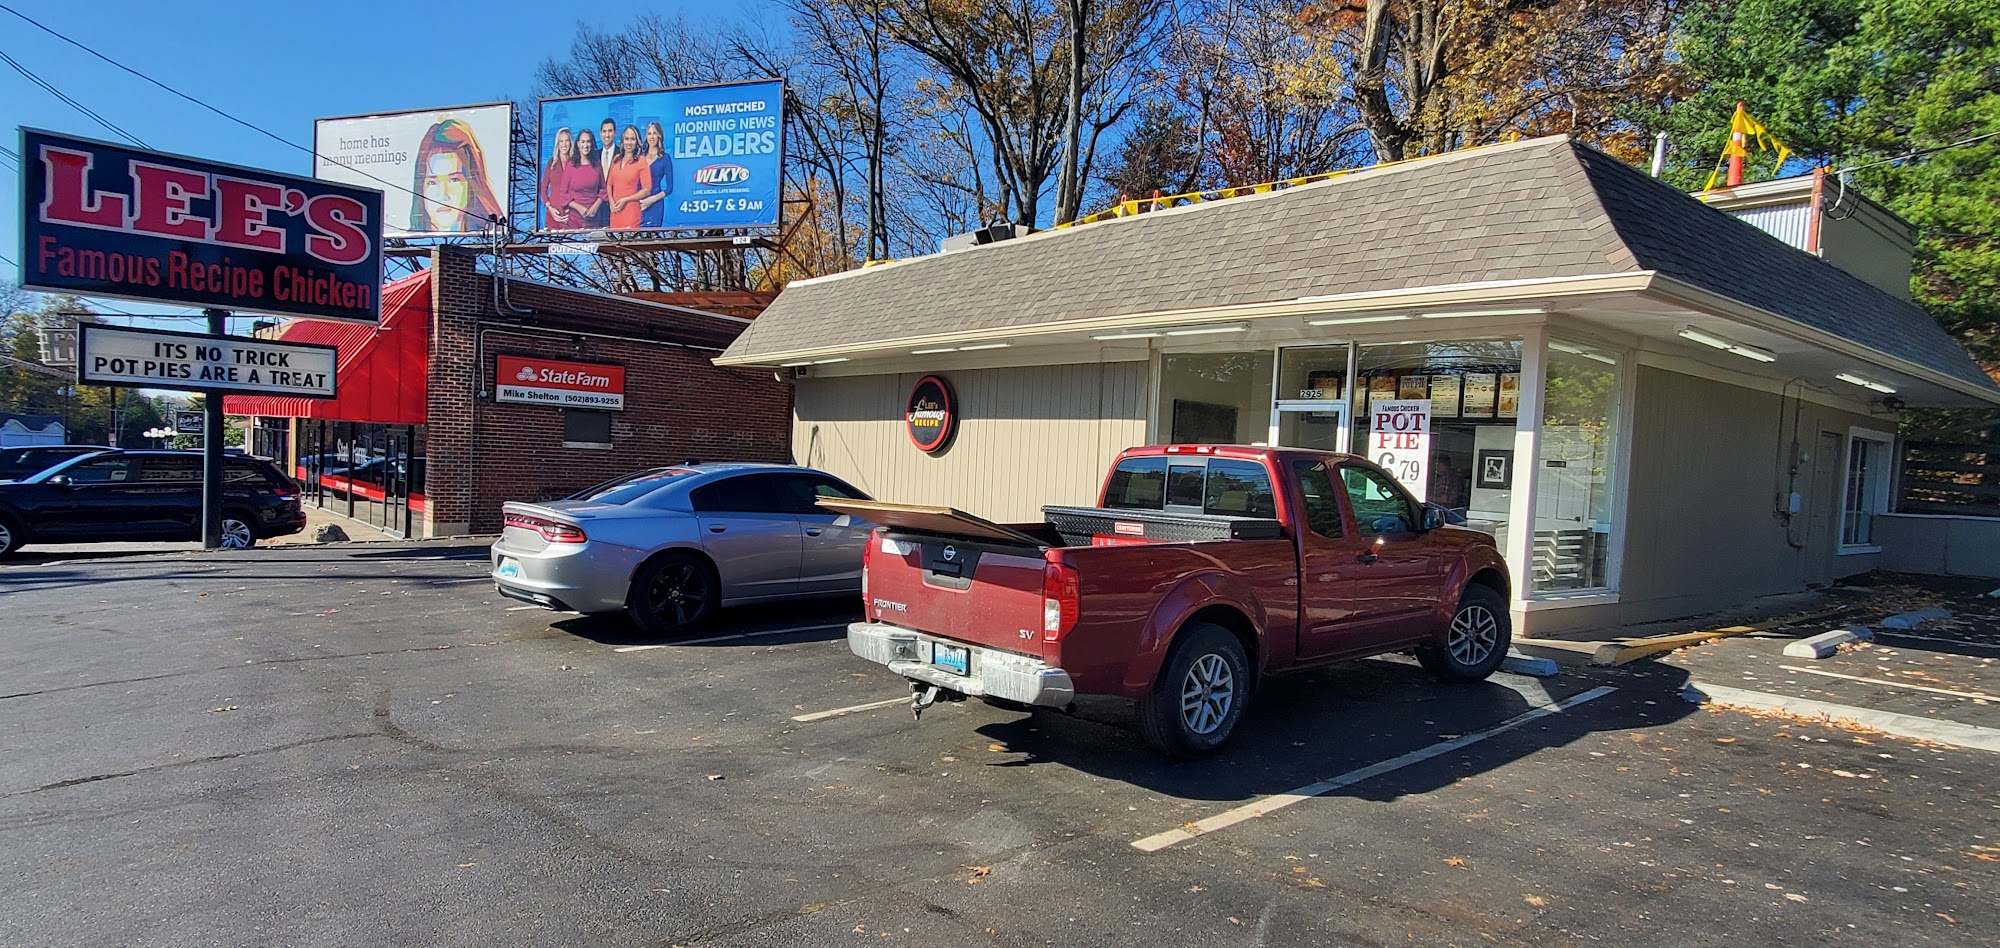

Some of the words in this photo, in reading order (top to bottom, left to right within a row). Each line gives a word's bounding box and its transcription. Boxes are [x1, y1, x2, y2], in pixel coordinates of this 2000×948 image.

[685, 105, 714, 116] MOST
[715, 101, 766, 114] WATCHED
[674, 119, 736, 134] MORNING
[739, 116, 776, 130] NEWS
[340, 137, 369, 150] home
[370, 135, 390, 148] has
[674, 131, 776, 159] LEADERS
[355, 150, 408, 166] meanings
[696, 168, 740, 183] WLKY
[39, 144, 372, 265] LEE'S
[680, 199, 723, 213] 4:30-7
[725, 198, 736, 211] &
[38, 235, 161, 287] Famous
[168, 249, 264, 298] Recipe
[273, 264, 371, 310] Chicken
[154, 342, 187, 359] ITS
[195, 346, 222, 362] NO
[233, 349, 290, 367] TRICK
[94, 356, 139, 375] POT
[144, 360, 191, 379] PIES
[199, 365, 239, 382] ARE
[247, 369, 261, 383] A
[268, 370, 327, 388] TREAT
[503, 389, 525, 399] Mike
[527, 391, 560, 401] Shelton
[564, 394, 620, 405] (502)893-9255
[1301, 390, 1322, 398] 2925
[1375, 413, 1426, 431] POT
[1377, 432, 1420, 450] PIE
[873, 599, 907, 612] FRONTIER
[1019, 629, 1035, 640] SV
